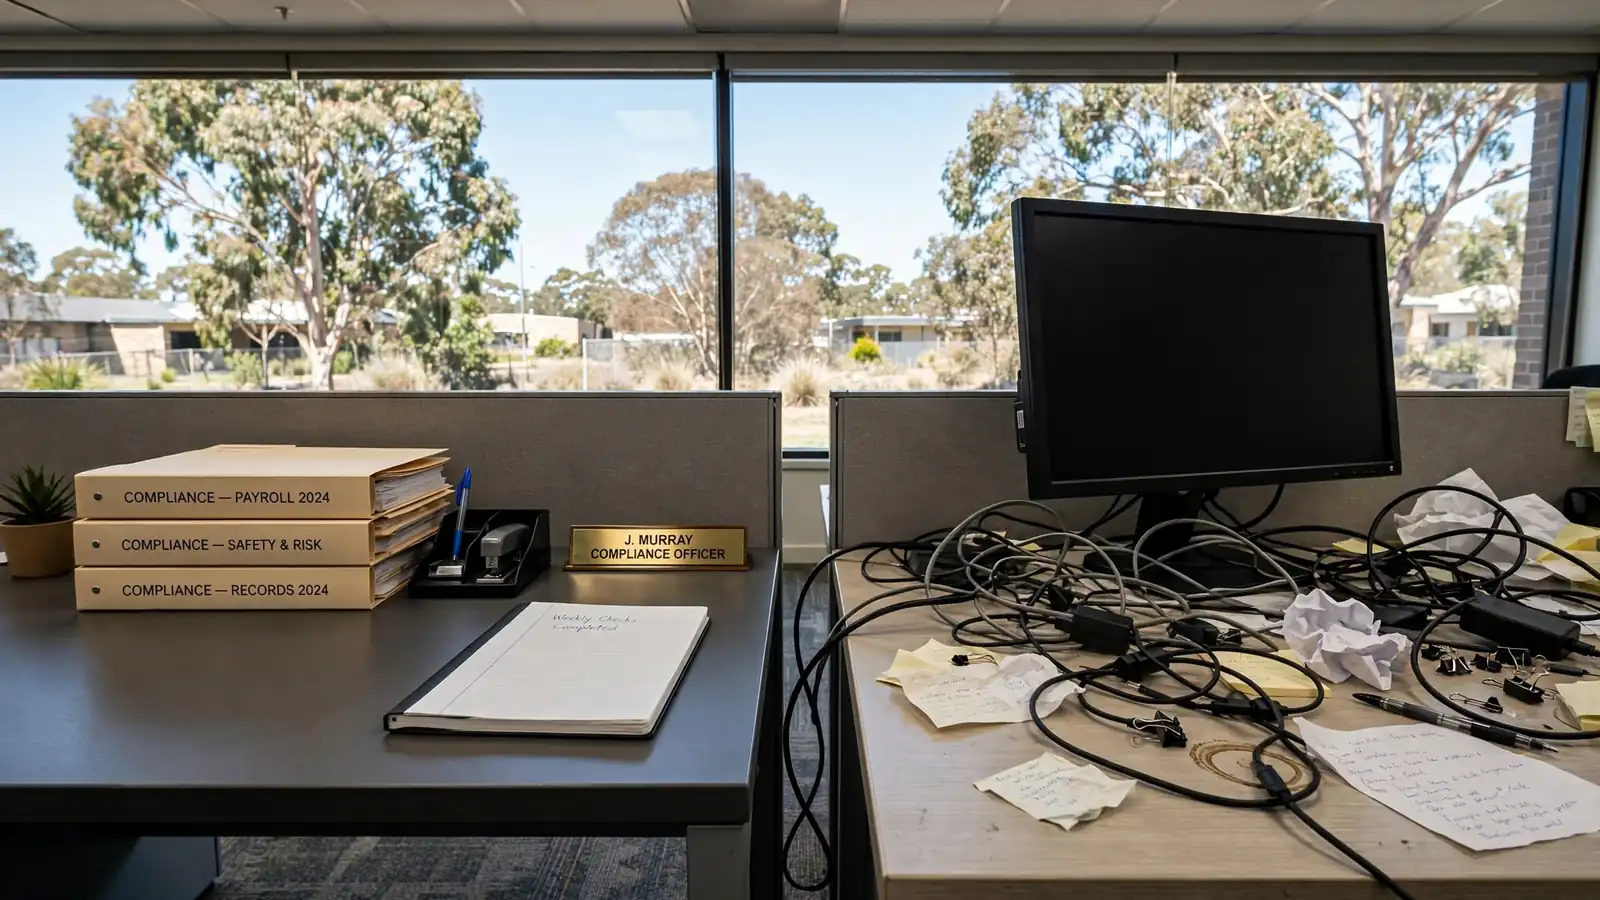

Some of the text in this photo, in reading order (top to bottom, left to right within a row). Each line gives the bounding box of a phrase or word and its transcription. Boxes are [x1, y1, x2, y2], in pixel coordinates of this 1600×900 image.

[124, 491, 215, 504] COMPLIANCE
[235, 491, 295, 504] PAYROLL
[298, 491, 330, 504] 2024
[121, 538, 209, 551] COMPLIANCE
[227, 538, 276, 551] SAFETY
[279, 538, 290, 551] &
[293, 538, 323, 551] RISK
[624, 534, 694, 546] J. MURRAY
[590, 548, 726, 560] COMPLIANCE OFFICER
[122, 584, 212, 597] COMPLIANCE
[231, 584, 295, 597] RECORDS
[298, 584, 329, 597] 2024
[552, 613, 637, 624] Weekly Checks
[552, 624, 619, 633] Completed
